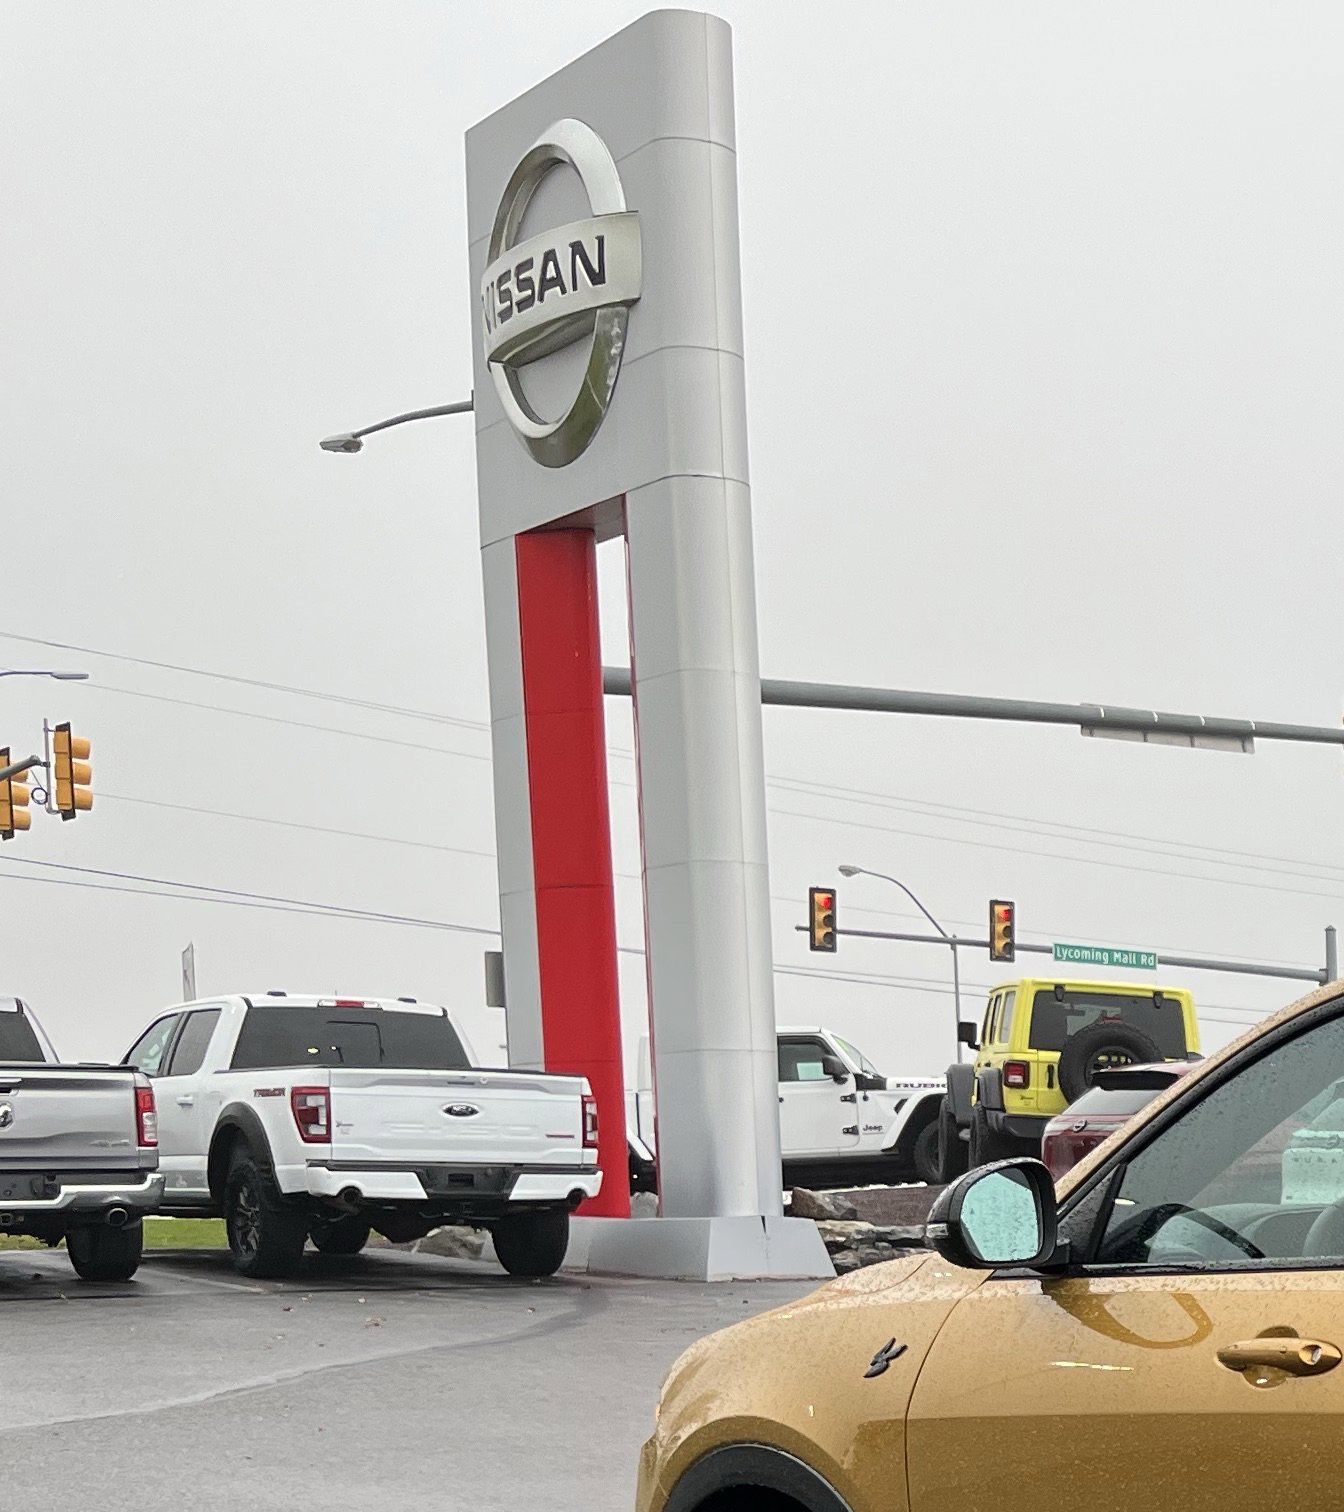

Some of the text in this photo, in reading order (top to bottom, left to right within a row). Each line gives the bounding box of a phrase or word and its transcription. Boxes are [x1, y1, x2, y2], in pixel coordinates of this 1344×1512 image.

[481, 235, 606, 334] NISSAN
[1056, 945, 1155, 966] Lycoming Mall Rd
[863, 1124, 883, 1132] Jeep
